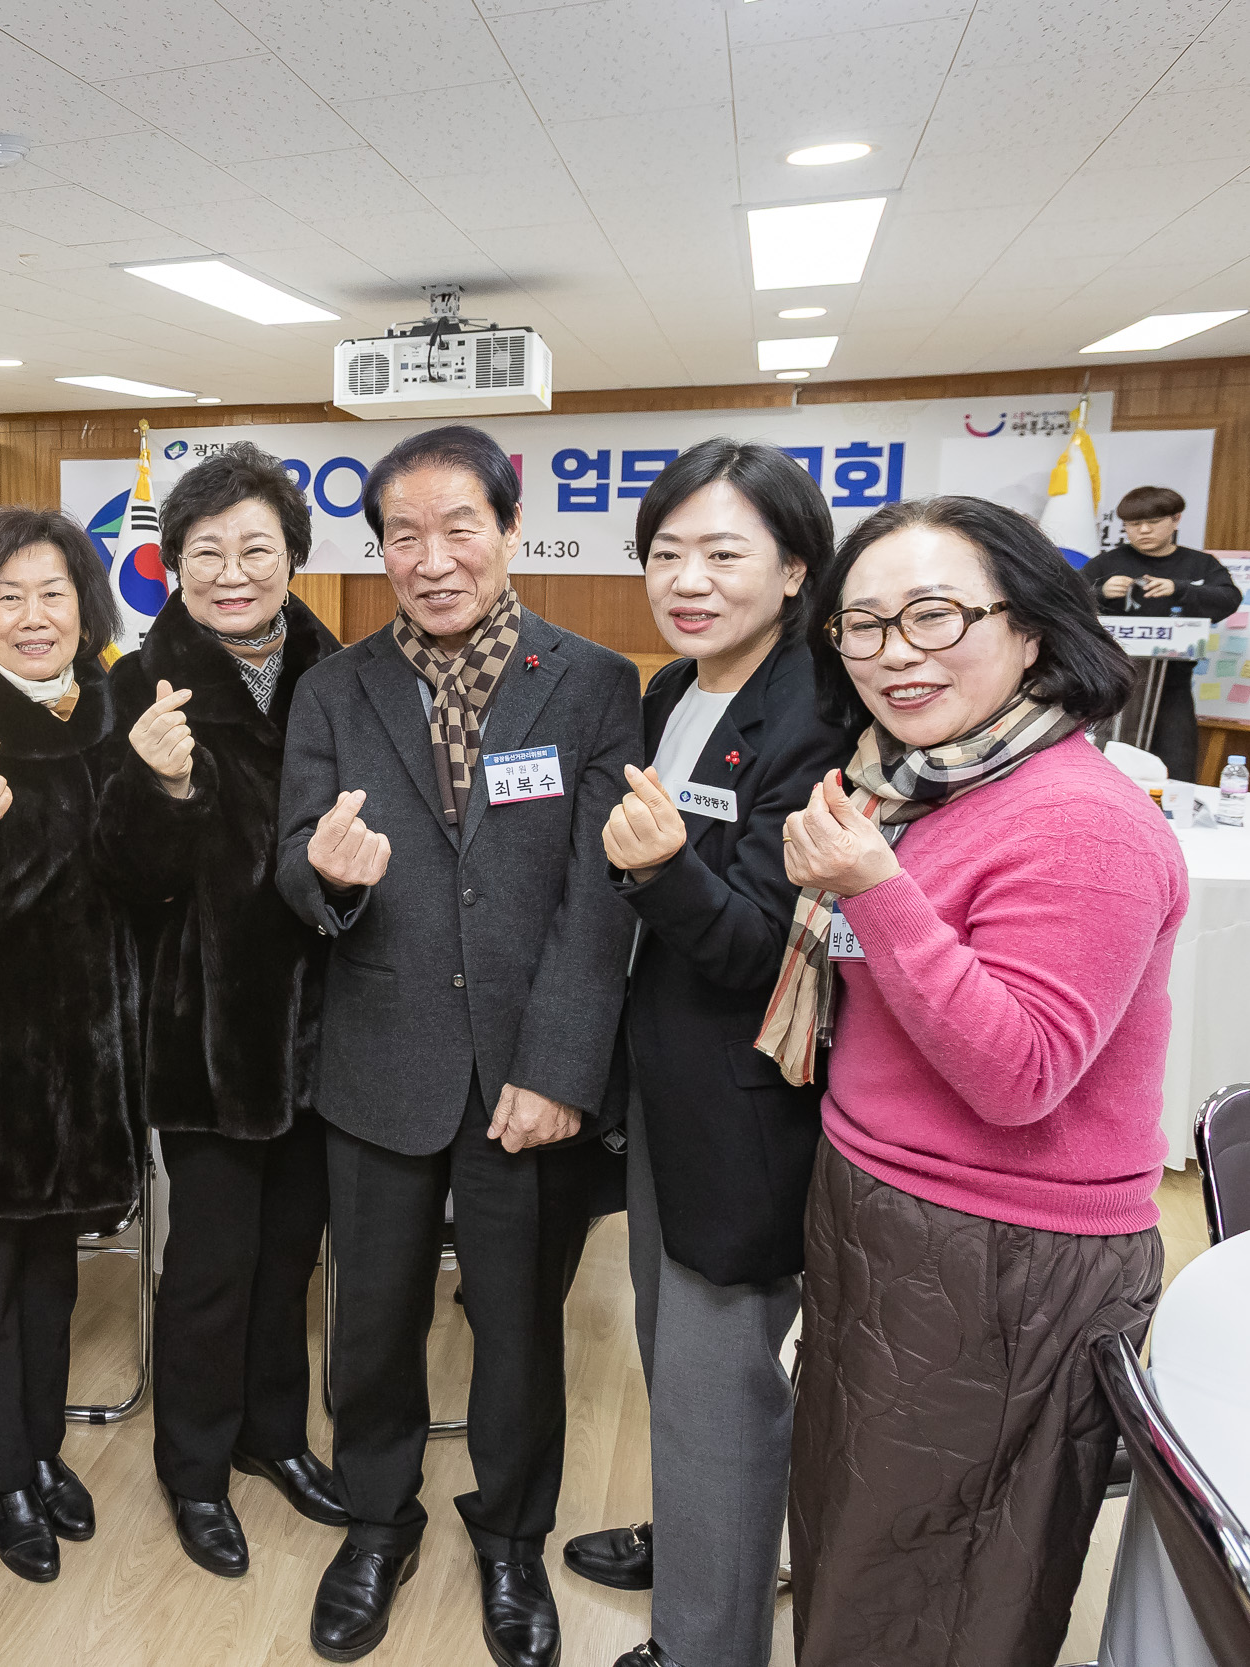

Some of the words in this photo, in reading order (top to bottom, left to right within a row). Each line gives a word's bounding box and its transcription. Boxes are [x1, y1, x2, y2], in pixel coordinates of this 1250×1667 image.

[522, 541, 580, 558] 14:30
[494, 774, 556, 797] 최복수
[832, 931, 862, 953] 박영
